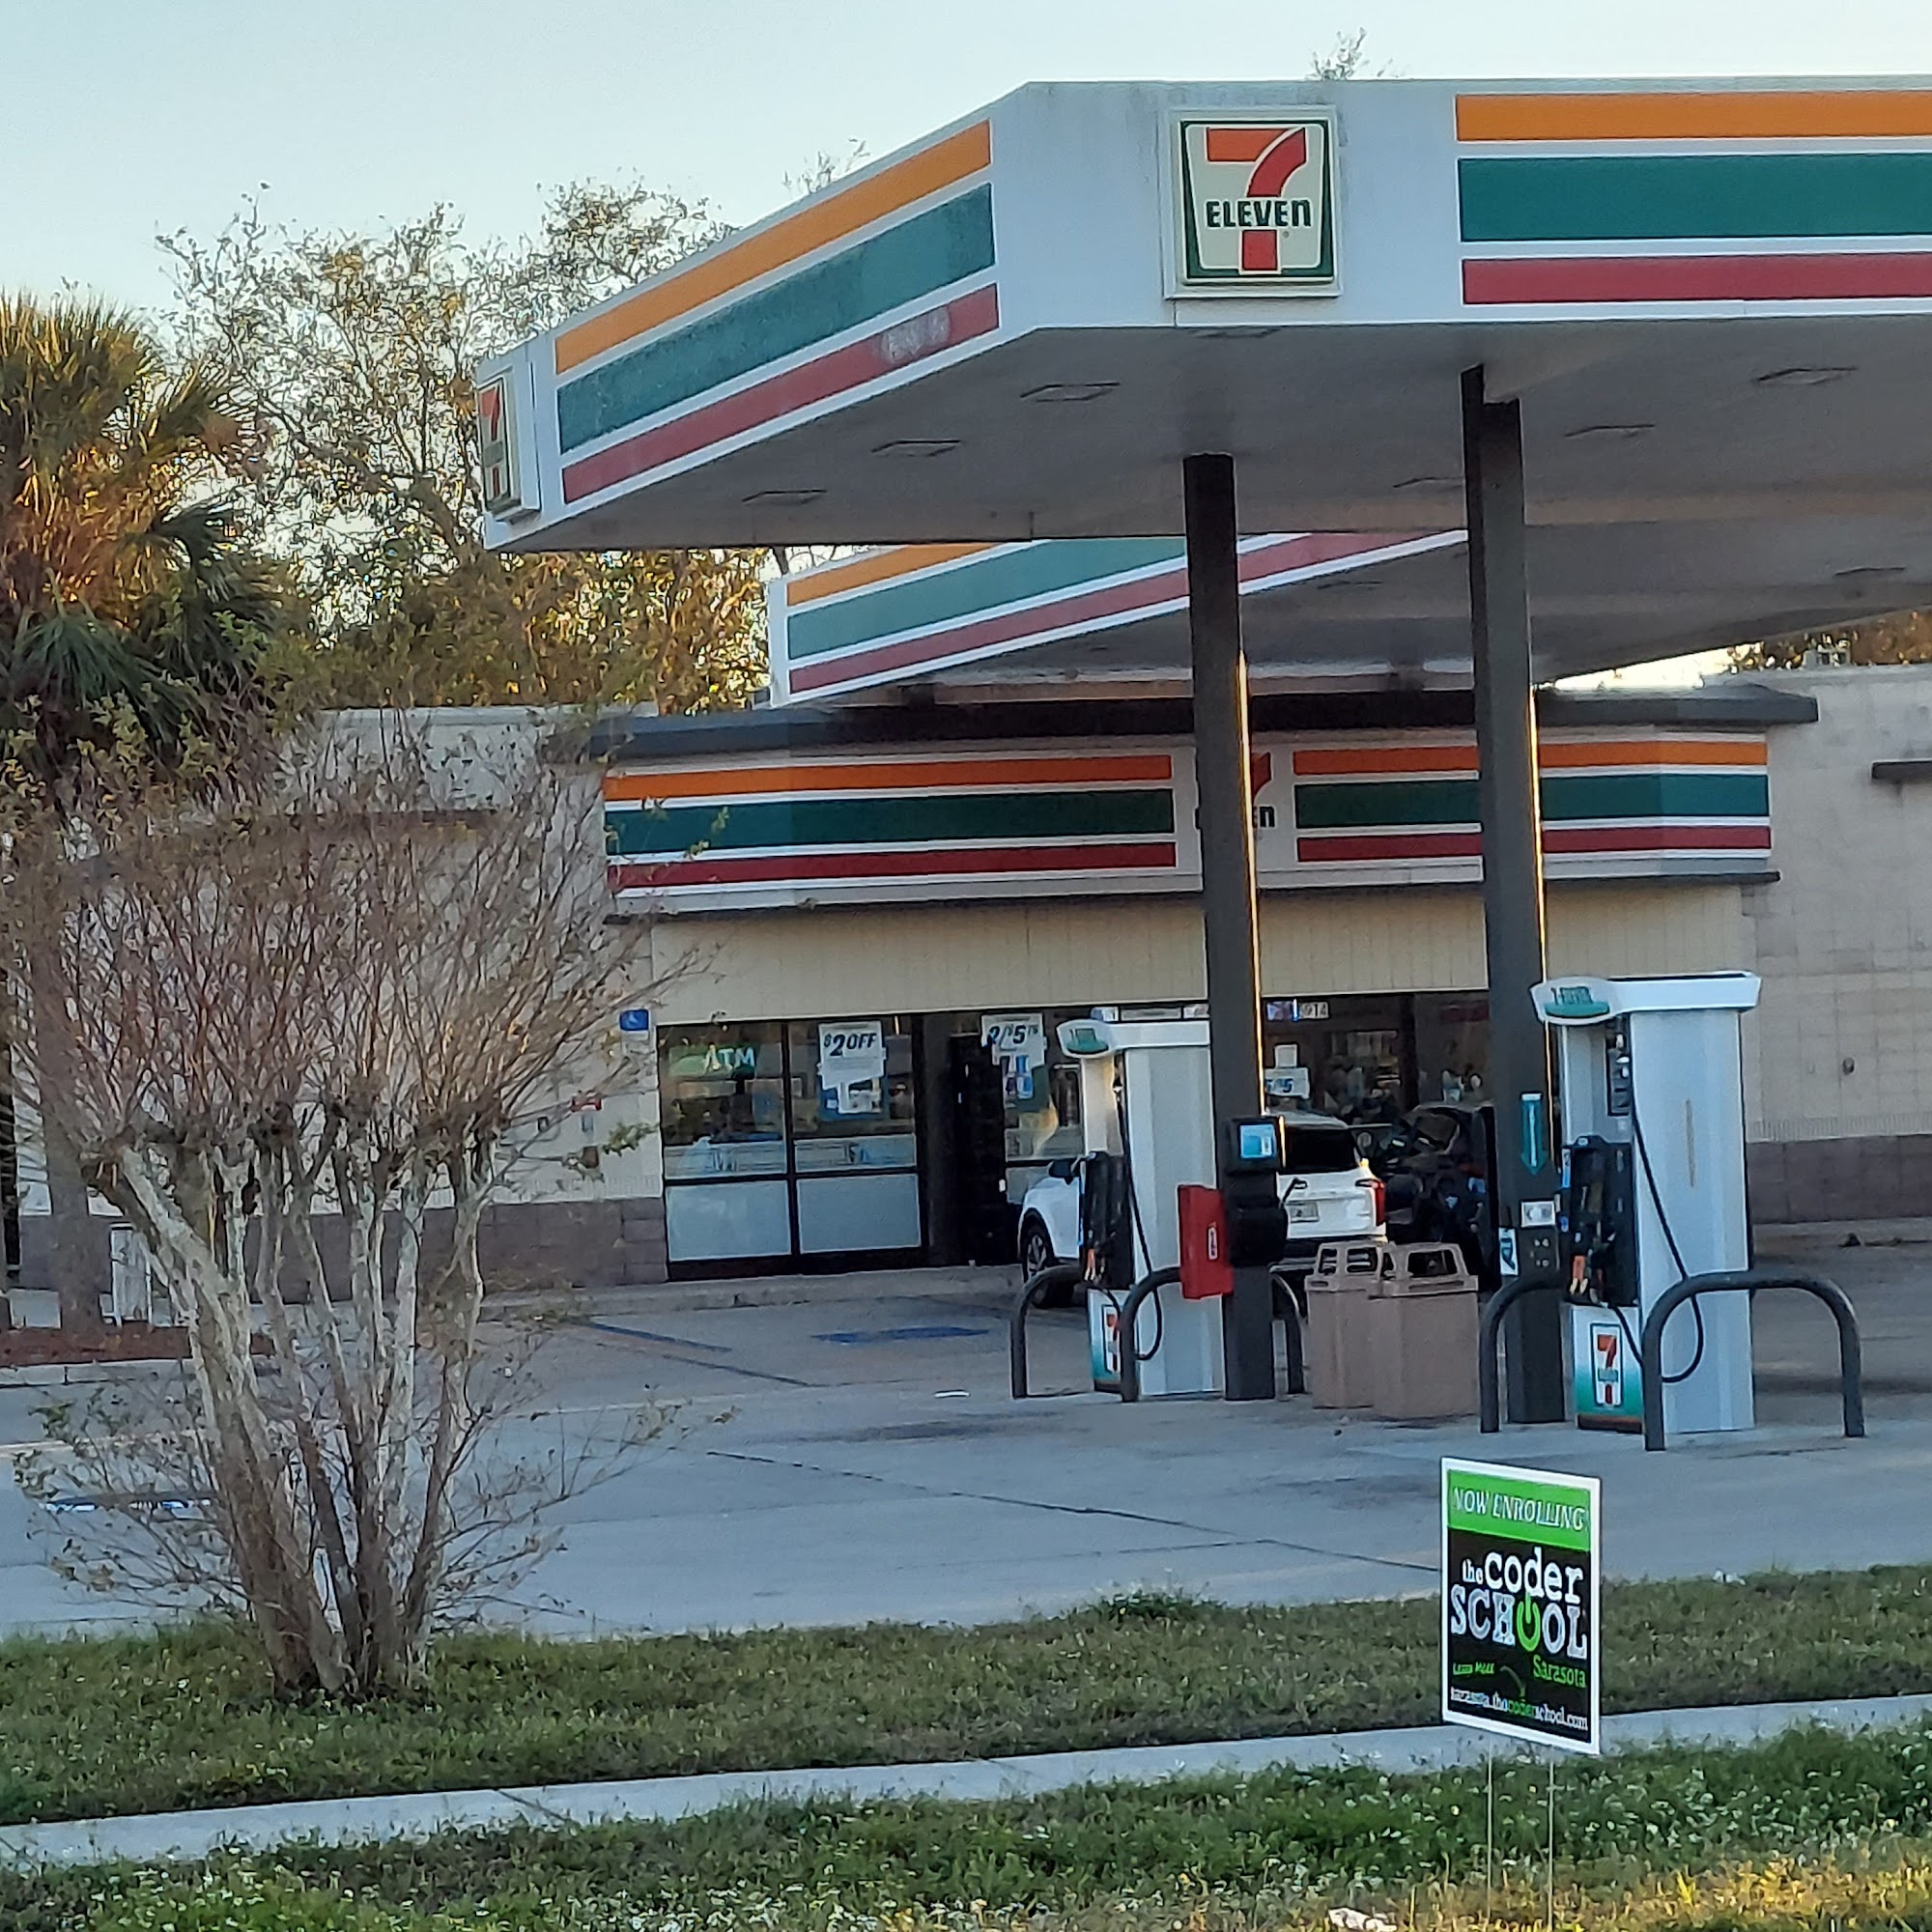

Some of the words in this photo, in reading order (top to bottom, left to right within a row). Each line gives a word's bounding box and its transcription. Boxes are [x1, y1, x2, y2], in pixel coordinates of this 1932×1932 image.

[846, 1034, 877, 1049] OFF
[1453, 1487, 1489, 1515] NOW
[1492, 1493, 1585, 1531] ENROLLING
[1484, 1546, 1583, 1604] coder
